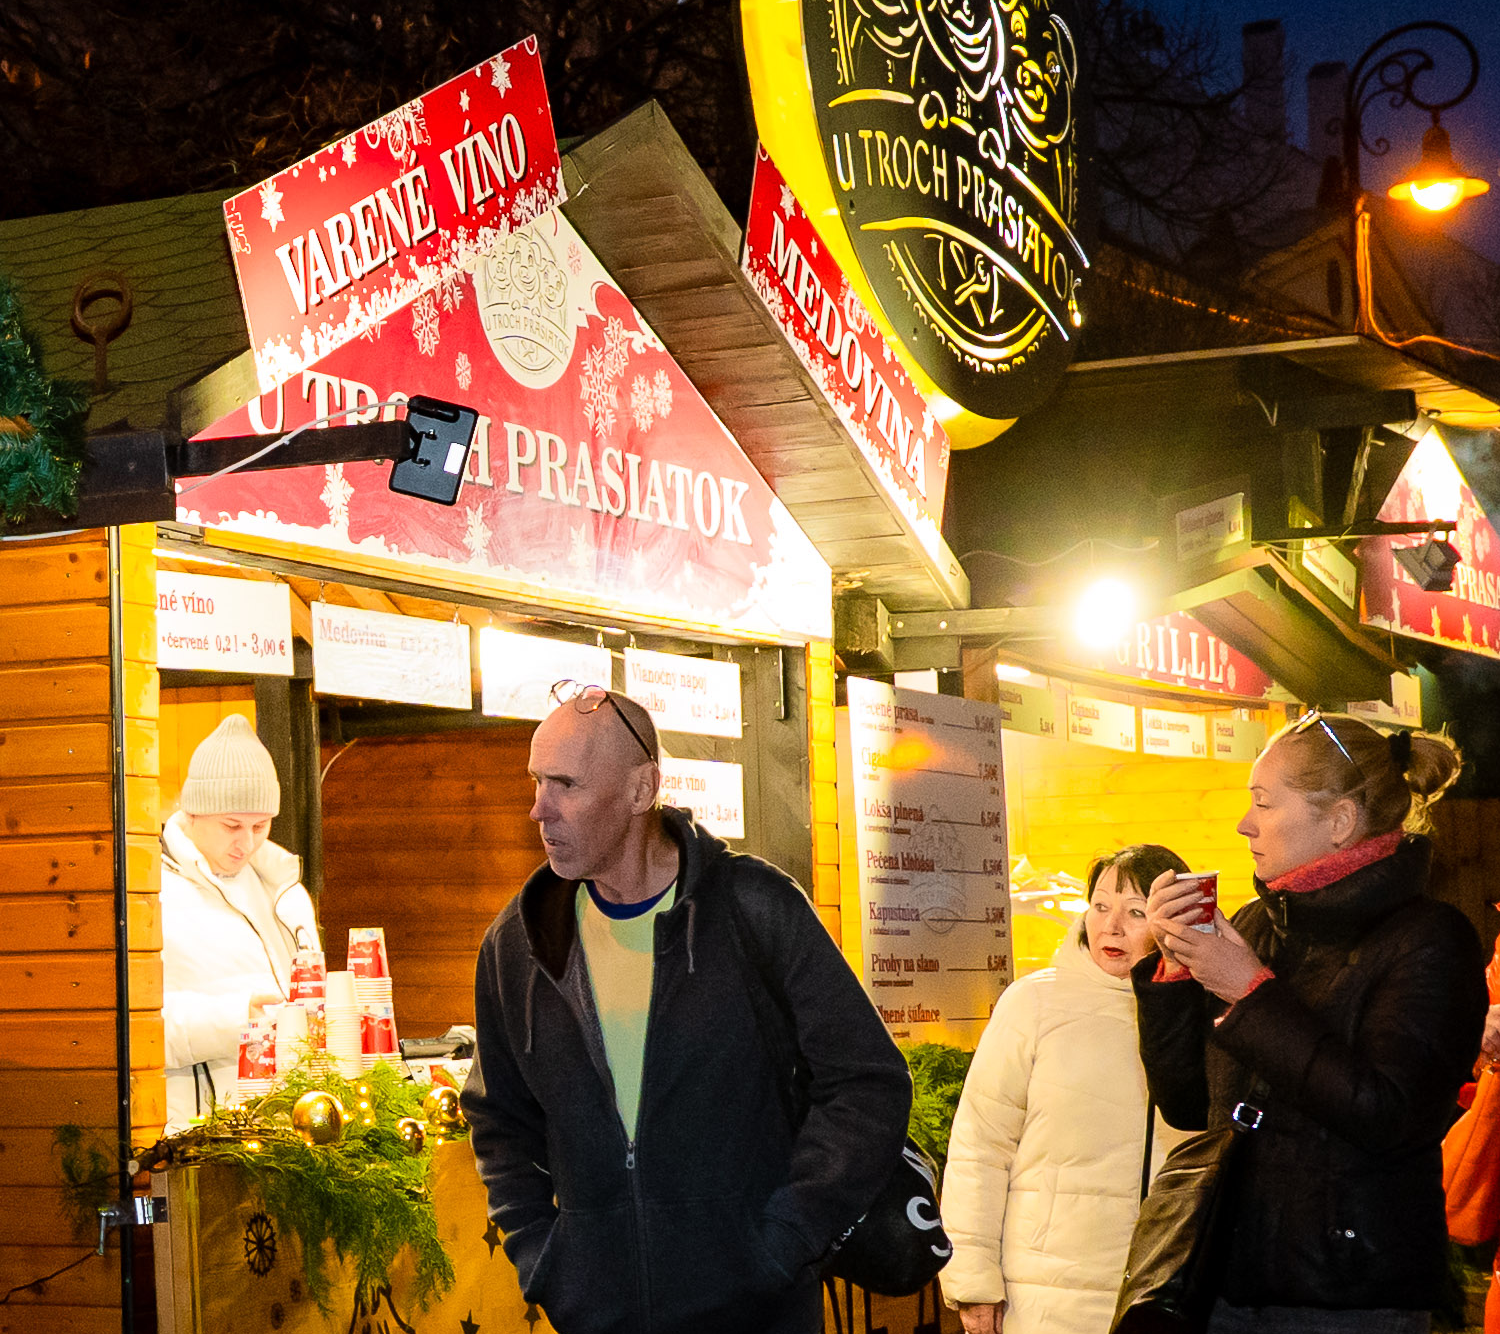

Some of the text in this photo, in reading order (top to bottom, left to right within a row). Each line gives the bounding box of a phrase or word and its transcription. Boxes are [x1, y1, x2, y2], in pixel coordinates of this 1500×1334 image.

[833, 132, 855, 191] U
[858, 129, 948, 201] TROCH
[275, 111, 527, 315] VARENÉ VÍNO
[764, 210, 929, 501] MEDOVINA
[302, 369, 496, 489] TRH
[505, 420, 753, 546] PRASIATOK
[184, 589, 214, 615] víno
[318, 617, 387, 648] Medovina
[864, 798, 891, 819] Lokša
